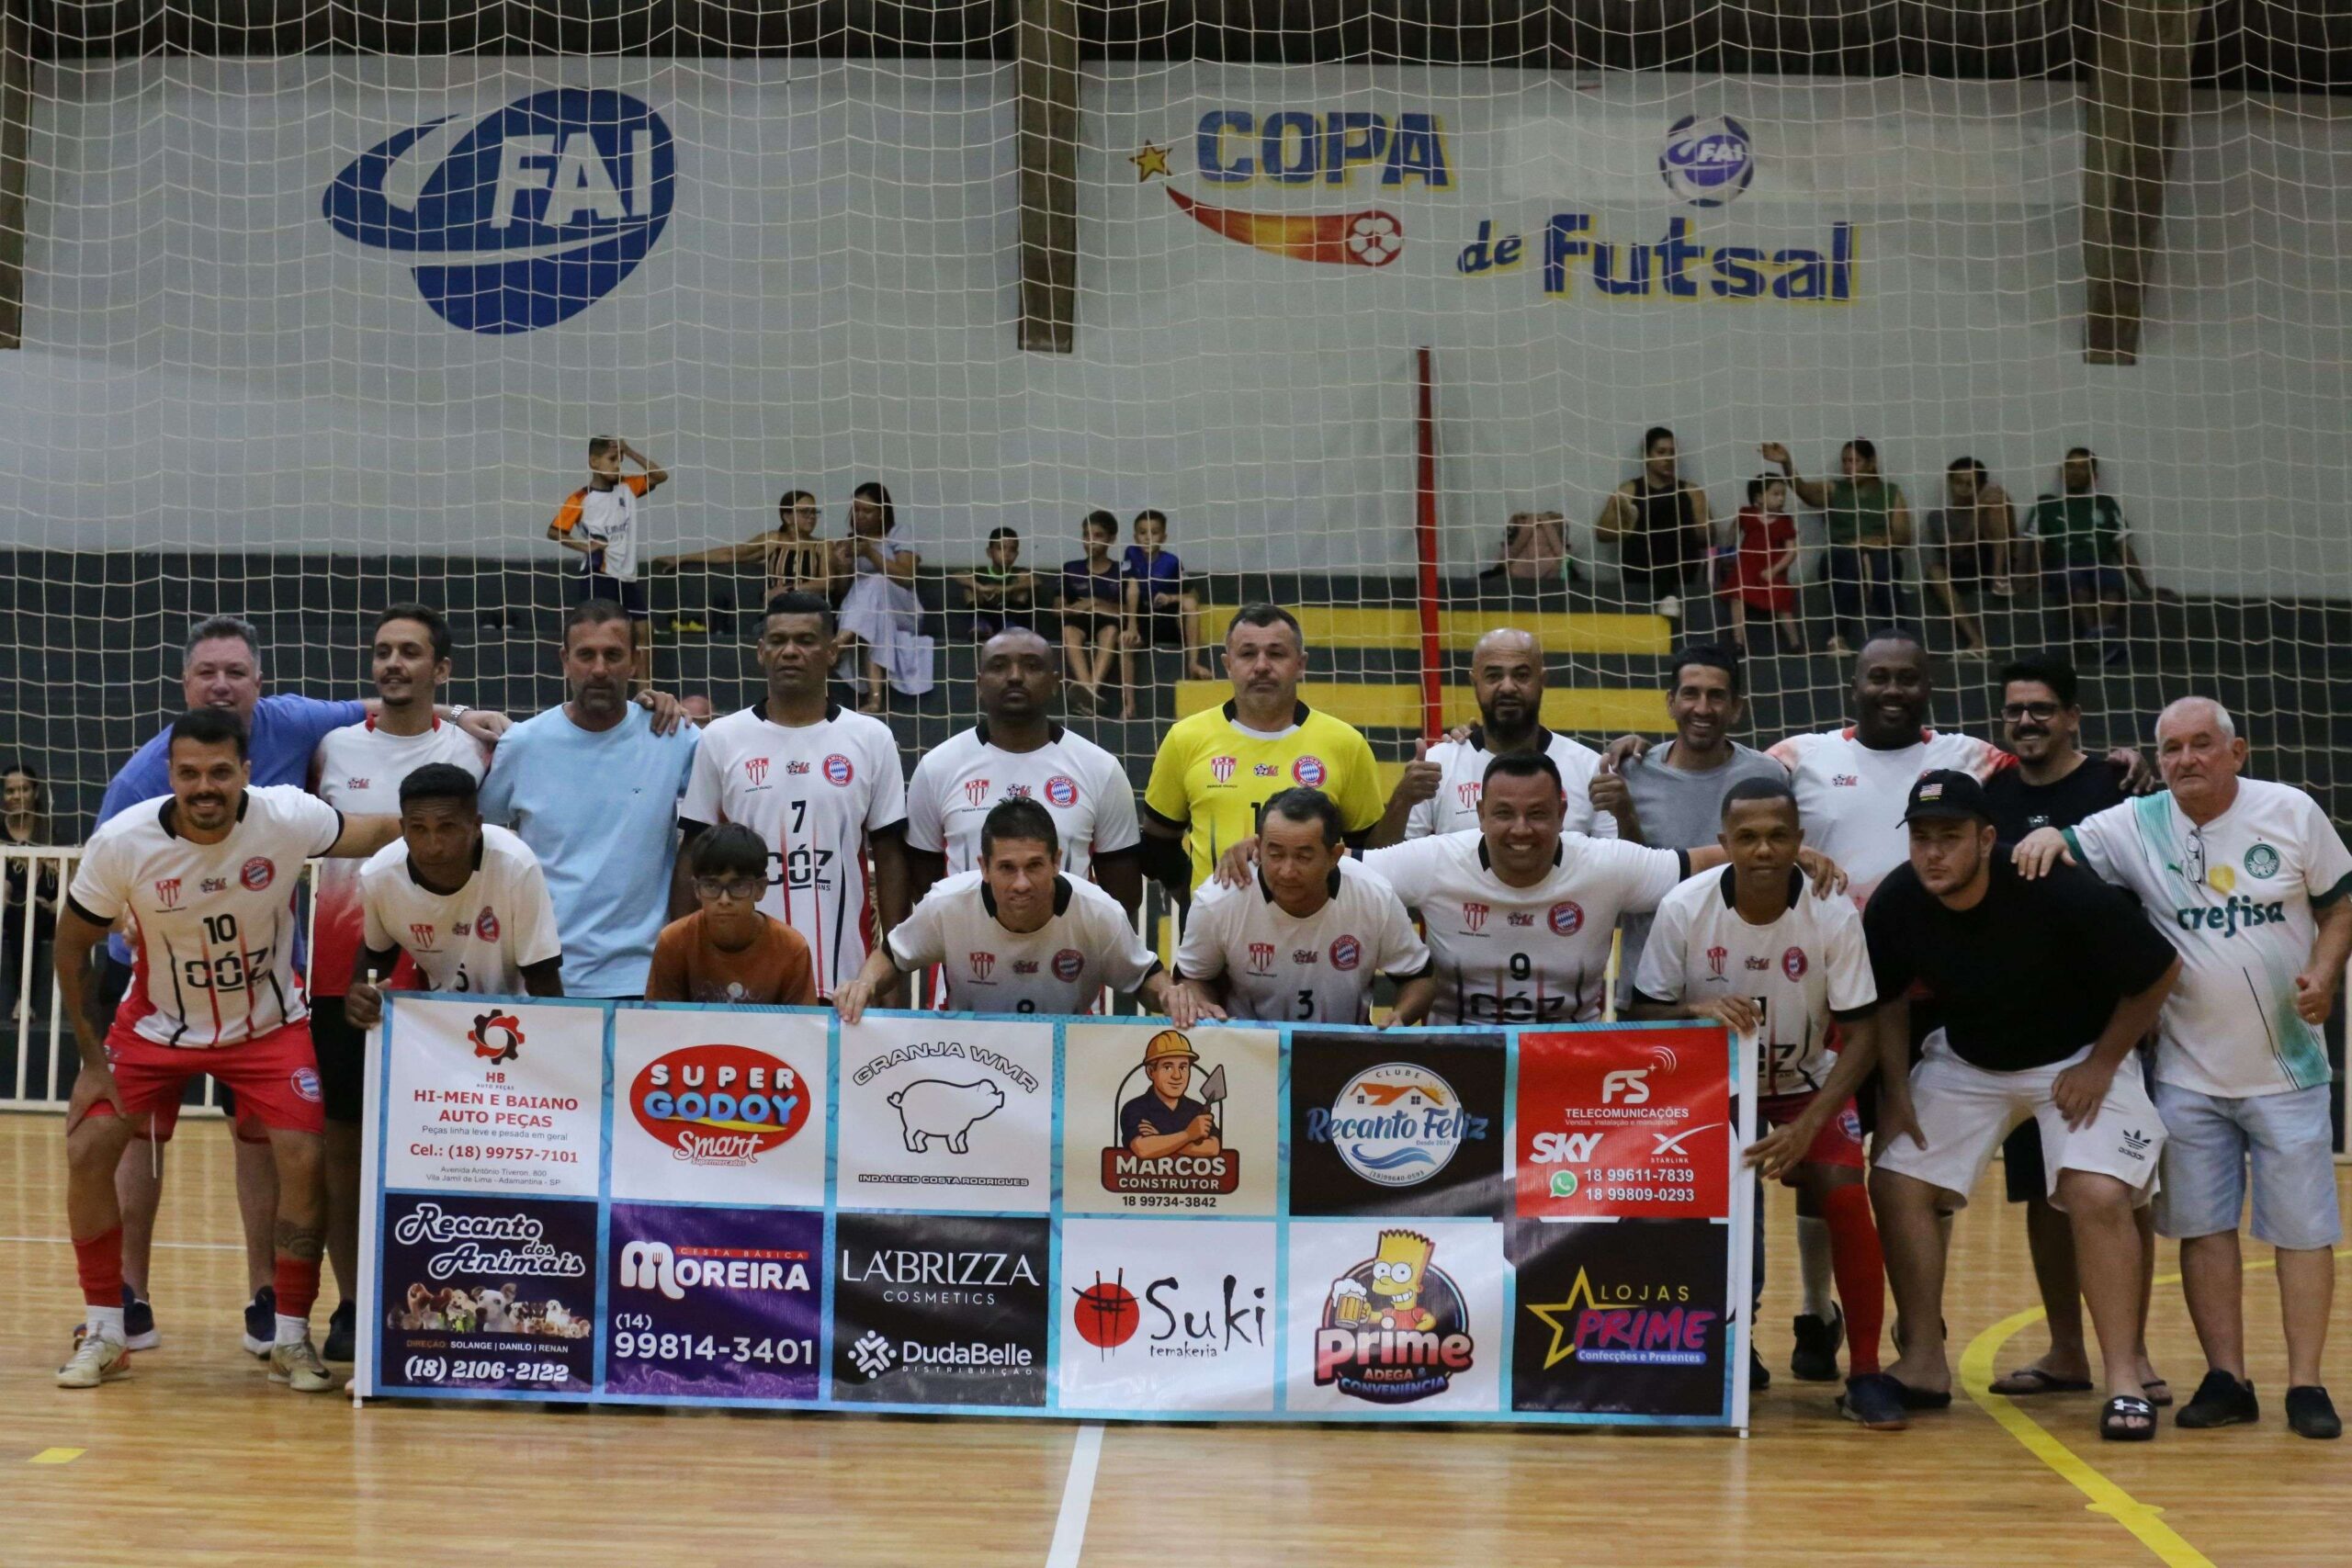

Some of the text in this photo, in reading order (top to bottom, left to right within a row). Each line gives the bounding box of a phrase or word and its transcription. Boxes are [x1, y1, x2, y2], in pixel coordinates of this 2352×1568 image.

[1197, 110, 1453, 188] COPA
[1697, 143, 1745, 163] FAI
[490, 130, 652, 229] FAI
[1457, 212, 1856, 304] de Futsal
[791, 800, 807, 833] 7
[2177, 895, 2287, 939] crefisa
[203, 914, 238, 945] 10
[1510, 953, 1531, 981] 9
[1297, 989, 1315, 1020] 3
[486, 1072, 505, 1083] HB
[650, 1064, 795, 1089] SUPER
[853, 1042, 1039, 1093] GRANJA WMR
[1375, 1068, 1421, 1079] CLUBE
[1602, 1069, 1650, 1104] FS
[414, 1089, 579, 1111] HI-MEN E BAIANO
[644, 1090, 798, 1124] GODOY
[439, 1110, 553, 1129] AUTO PEÇAS
[1566, 1107, 1690, 1120] TELECOMUNICAÇÕES
[422, 1125, 447, 1136] Peças
[450, 1126, 469, 1135] linha
[472, 1127, 489, 1136] leve
[500, 1129, 529, 1139] pesada
[547, 1133, 568, 1142] geral
[1306, 1107, 1489, 1144] Recanto Feliz
[411, 1144, 578, 1163] Cel.: (18) 99757-7101
[673, 1131, 763, 1163] Smart
[1529, 1133, 1604, 1164] SKY
[441, 1166, 470, 1174] Avenida
[472, 1166, 499, 1175] Antônio
[1115, 1155, 1227, 1177] MARCOS
[1585, 1168, 1694, 1182] 18 99611-7839
[426, 1173, 440, 1181] Vila
[499, 1177, 542, 1185] Adamantina
[858, 1174, 1029, 1186] INDALECIO COSTA RODRIGUES
[1118, 1178, 1219, 1190] CONSTRUTOR
[1123, 1196, 1216, 1208] 18 99734-3842
[1586, 1189, 1694, 1201] 18 99809-0293
[395, 1203, 543, 1245] Recanto
[522, 1241, 556, 1258] dos
[680, 1247, 730, 1258] CESTA
[427, 1243, 586, 1280] Animais
[620, 1240, 810, 1300] MOREIRA
[883, 1291, 995, 1304] COSMETICS
[1600, 1284, 1690, 1302] LOJAS
[616, 1313, 652, 1330] (14)
[1146, 1274, 1266, 1351] Suki
[1574, 1305, 1717, 1349] PRIME
[450, 1341, 492, 1351] SOLANGE
[499, 1342, 532, 1351] DANILO
[538, 1344, 569, 1353] RENAN
[615, 1332, 812, 1365] 99814-3401
[903, 1340, 1033, 1366] DudaBelle
[1150, 1341, 1218, 1359] temakeria
[1578, 1350, 1701, 1364] Confecções e Presentes
[405, 1356, 570, 1382] (18) 2106-2122
[1363, 1368, 1413, 1381] ADEGA
